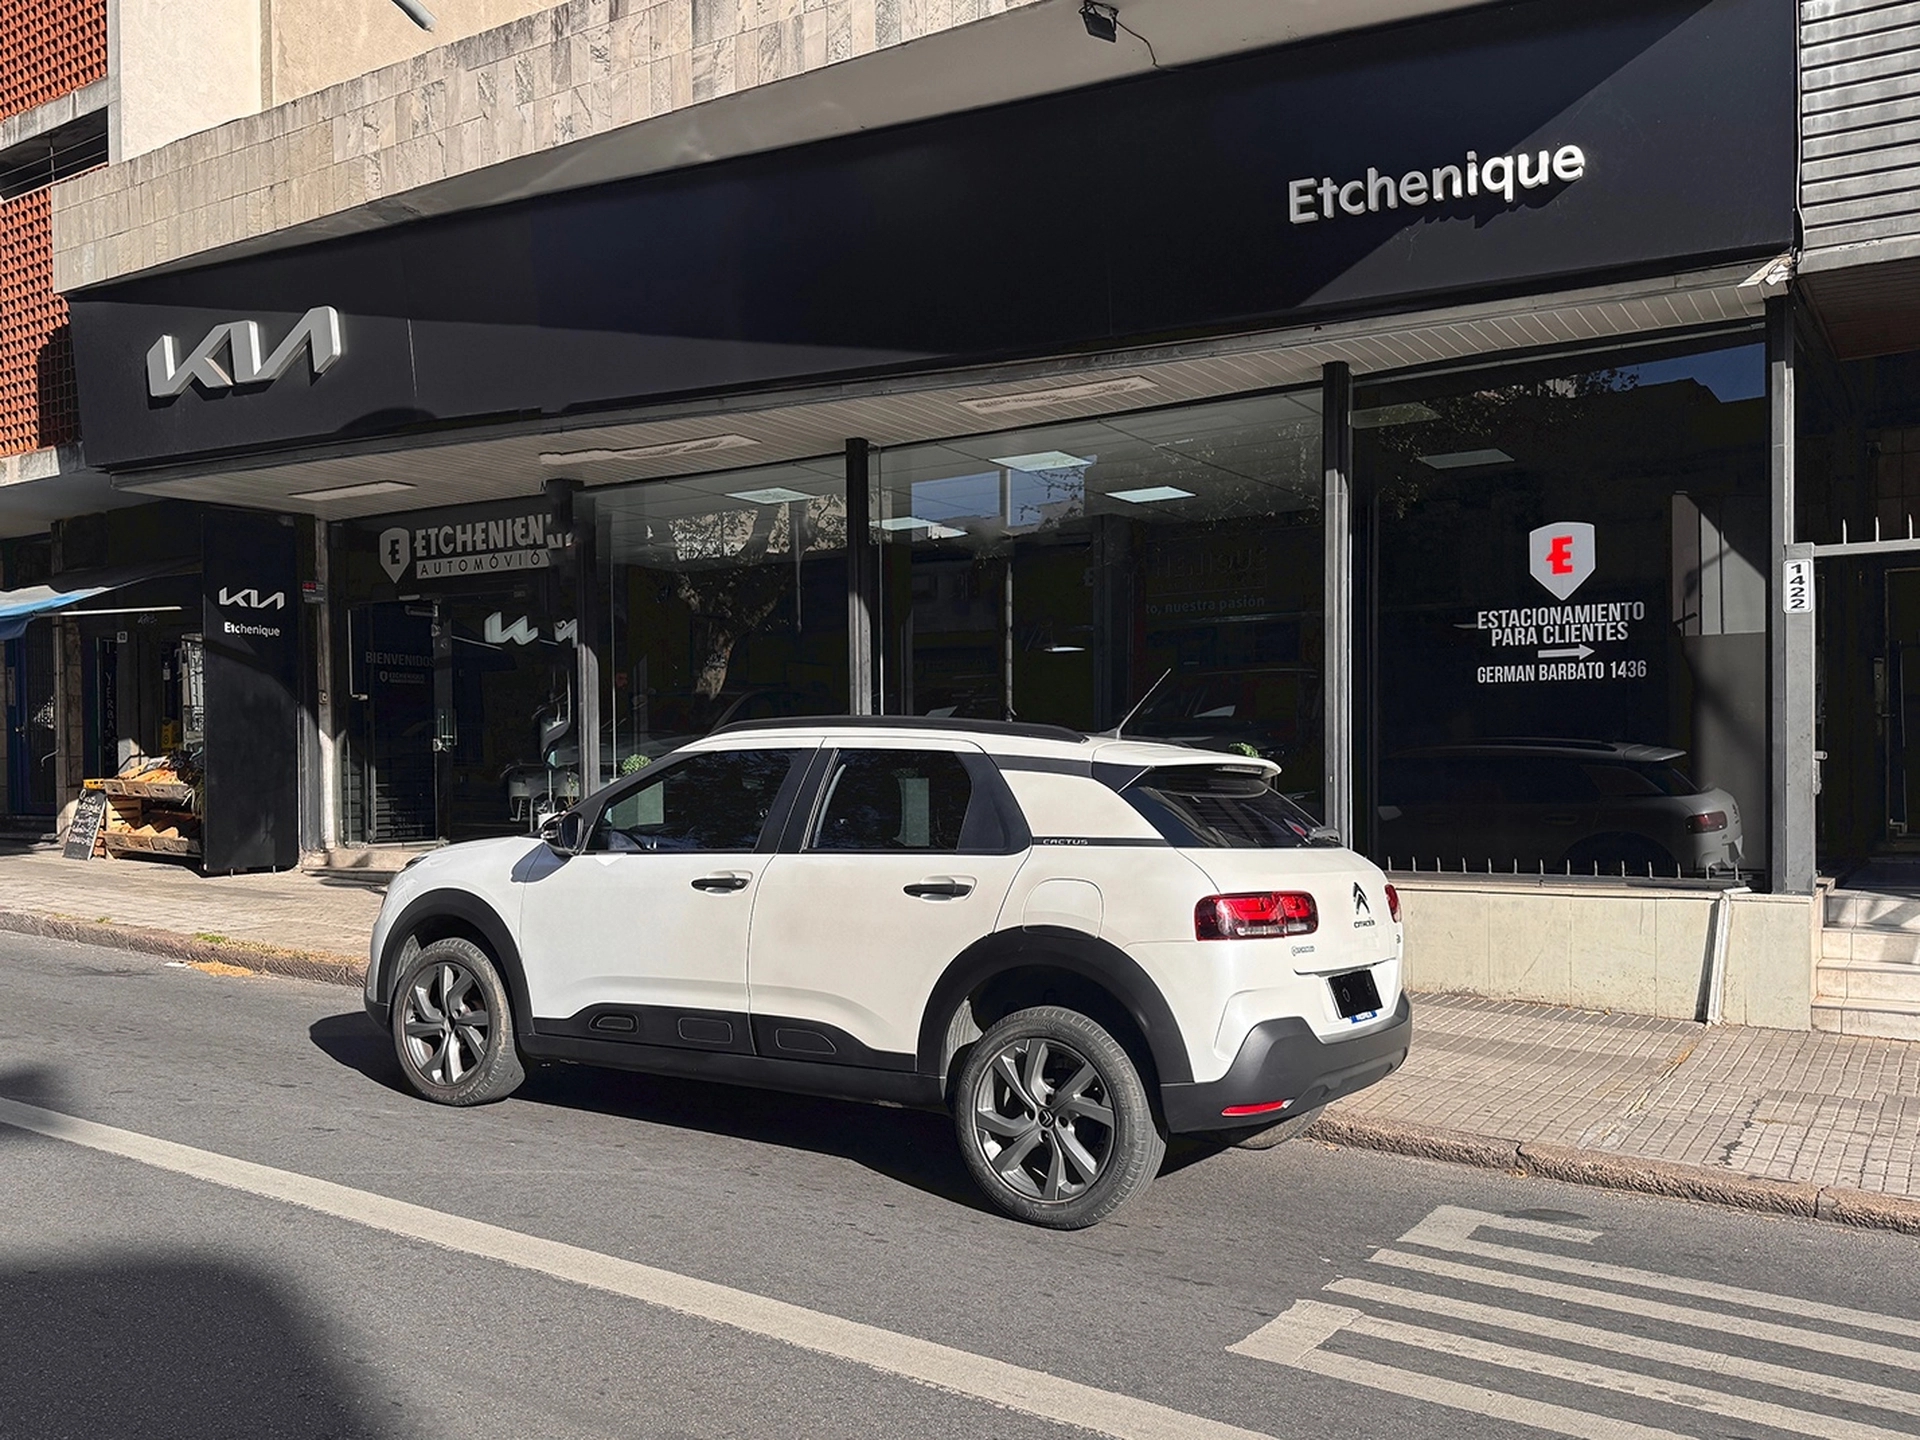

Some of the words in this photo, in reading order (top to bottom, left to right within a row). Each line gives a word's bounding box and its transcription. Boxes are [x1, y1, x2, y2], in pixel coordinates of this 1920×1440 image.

[1288, 145, 1586, 224] Etchenique
[146, 304, 343, 399] KIA
[218, 586, 286, 610] KIA
[1789, 563, 1806, 609] 1422
[1477, 601, 1645, 629] ESTACIONAMIENTO
[224, 621, 280, 638] Etchenique
[1491, 627, 1538, 647] PARA
[1543, 621, 1629, 645] CLIENTES
[365, 651, 436, 669] BIENVENIDOS
[1477, 664, 1535, 684] GERMAN
[1538, 661, 1605, 681] BARBATO
[1610, 659, 1647, 679] 1436
[1042, 838, 1089, 846] CACTUS
